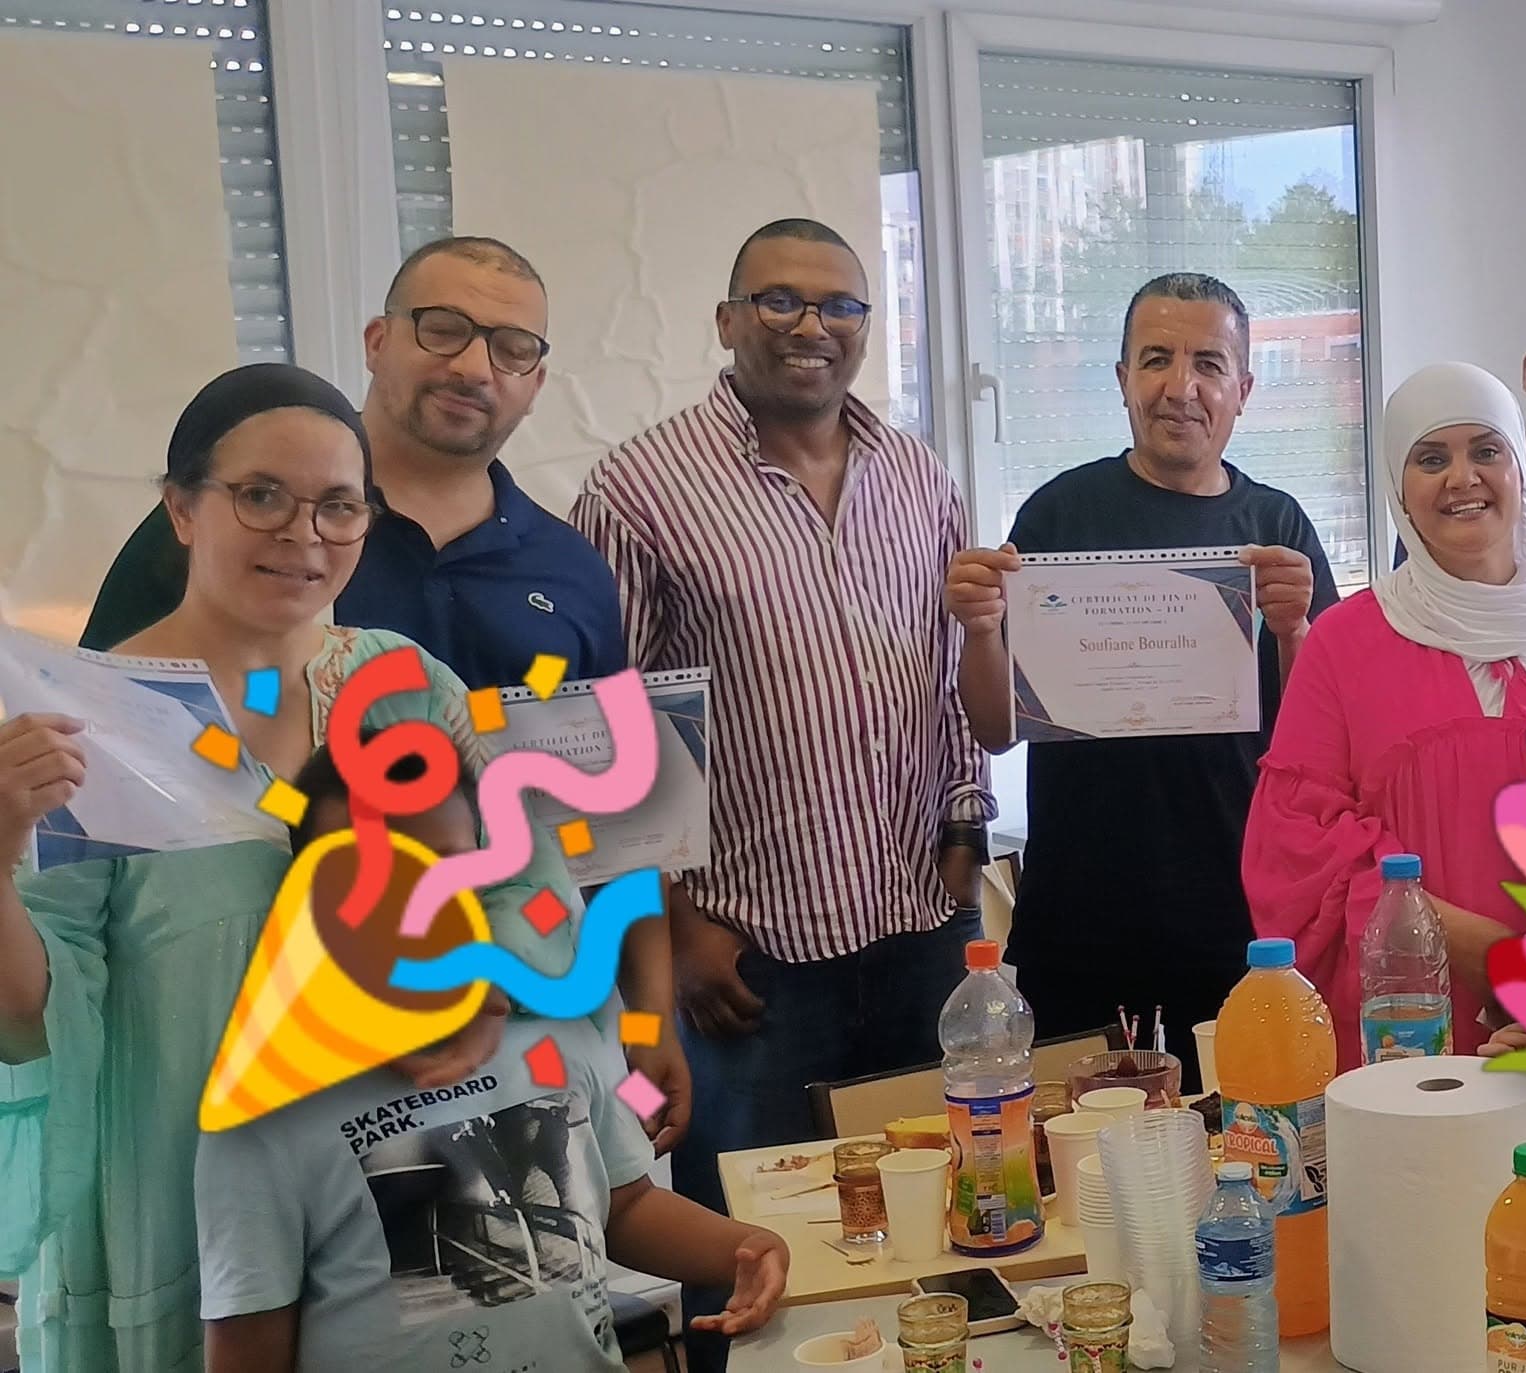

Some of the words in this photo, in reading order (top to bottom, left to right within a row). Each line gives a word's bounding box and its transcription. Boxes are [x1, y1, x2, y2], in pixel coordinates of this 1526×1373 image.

[1071, 594, 1137, 604] CERTIFICAT
[1085, 606, 1152, 616] FORMATION
[1079, 637, 1135, 653] Soufiane
[1139, 634, 1198, 650] Bouralha
[340, 1074, 498, 1139] SKATEBOARD
[349, 1113, 425, 1155] PARK.
[1497, 1359, 1518, 1371] PUR
